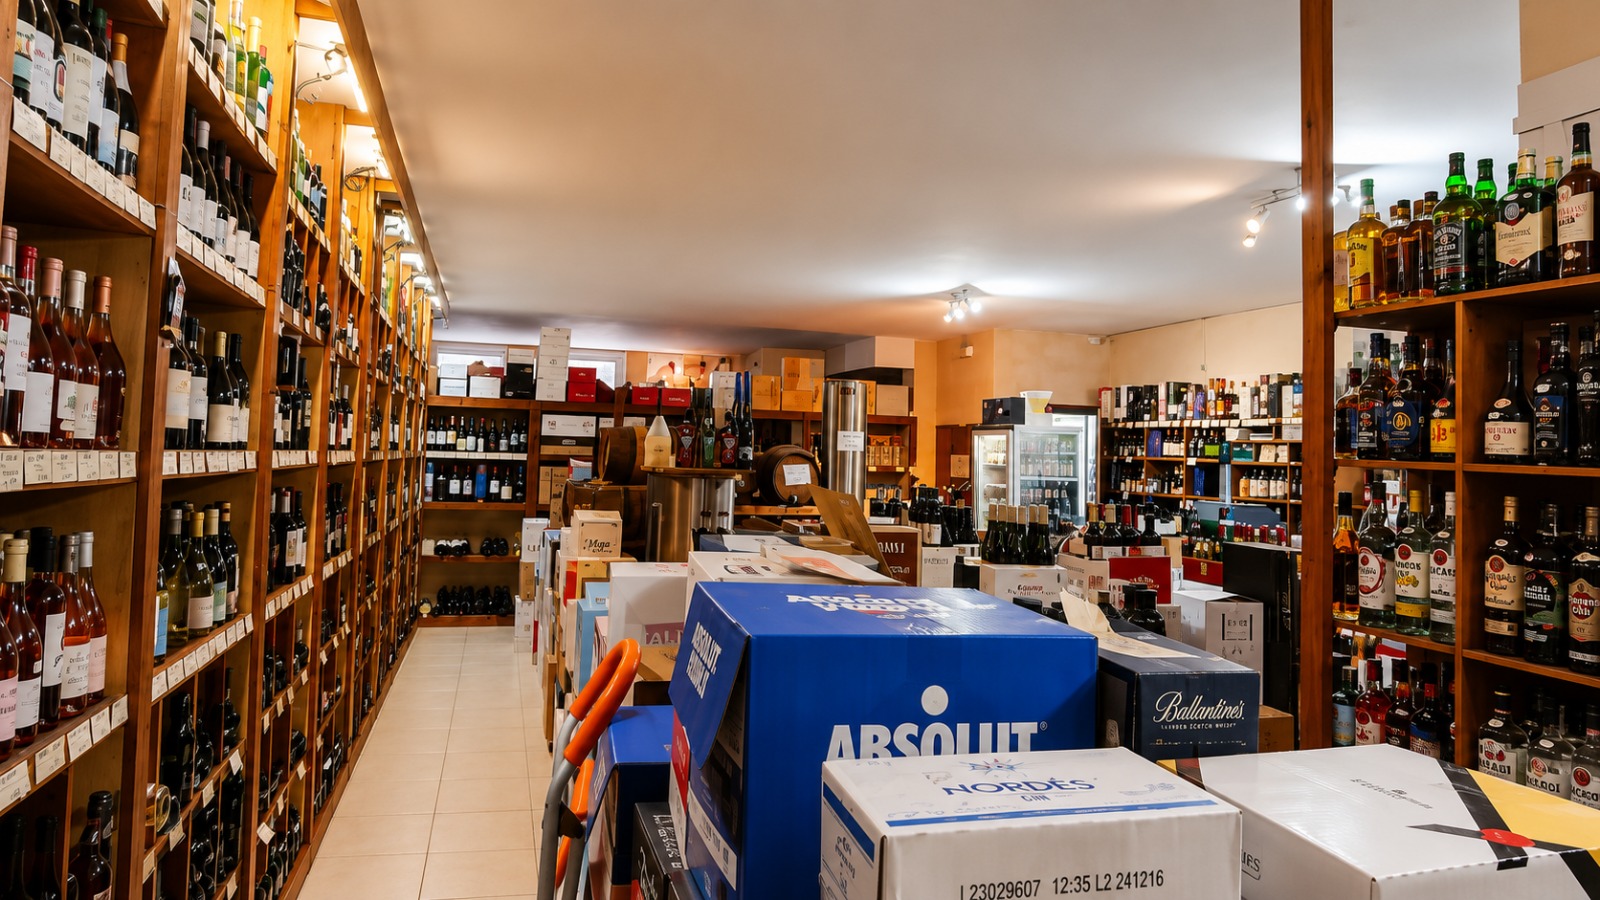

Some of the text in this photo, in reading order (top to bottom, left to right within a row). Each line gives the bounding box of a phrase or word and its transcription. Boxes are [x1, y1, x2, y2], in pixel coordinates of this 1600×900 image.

[1153, 691, 1245, 723] Ballantine's
[942, 776, 1095, 797] NORDÉS
[969, 879, 1041, 900] 23029607
[1053, 874, 1091, 895] 12:35
[1095, 873, 1112, 892] L2
[1115, 869, 1164, 891] 241216
